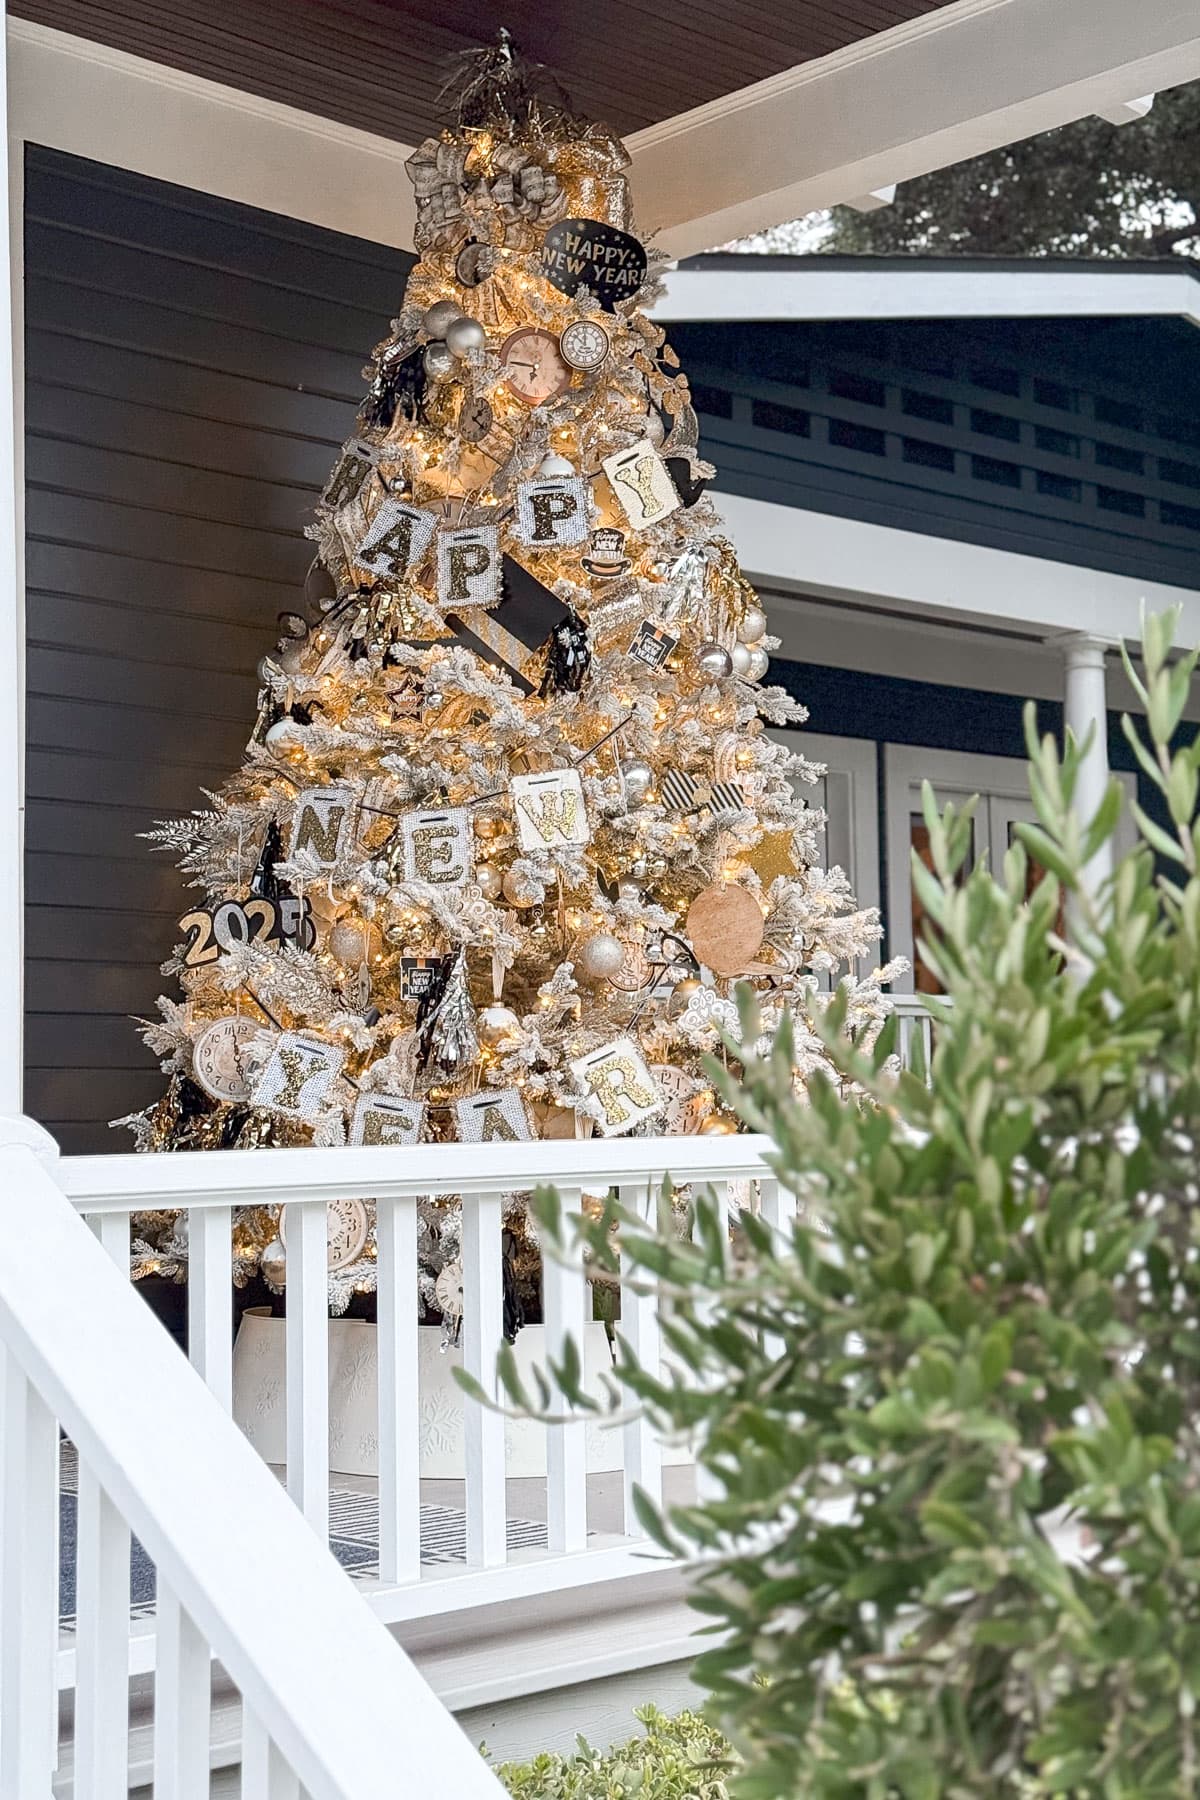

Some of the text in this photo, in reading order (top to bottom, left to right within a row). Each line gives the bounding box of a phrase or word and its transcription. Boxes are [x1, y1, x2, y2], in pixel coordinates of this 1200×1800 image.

[565, 231, 630, 266] HAPPY
[542, 246, 647, 286] NEW YEAR!
[595, 541, 618, 550] NEW
[179, 898, 313, 965] 2025
[204, 1048, 211, 1057] 9
[205, 1062, 213, 1073] 8
[215, 1076, 222, 1085] 7
[661, 1072, 671, 1085] 12
[228, 1081, 236, 1091] 6
[685, 1104, 694, 1117] 3
[344, 1202, 352, 1215] 2
[347, 1218, 356, 1232] 3
[333, 1246, 341, 1260] 5
